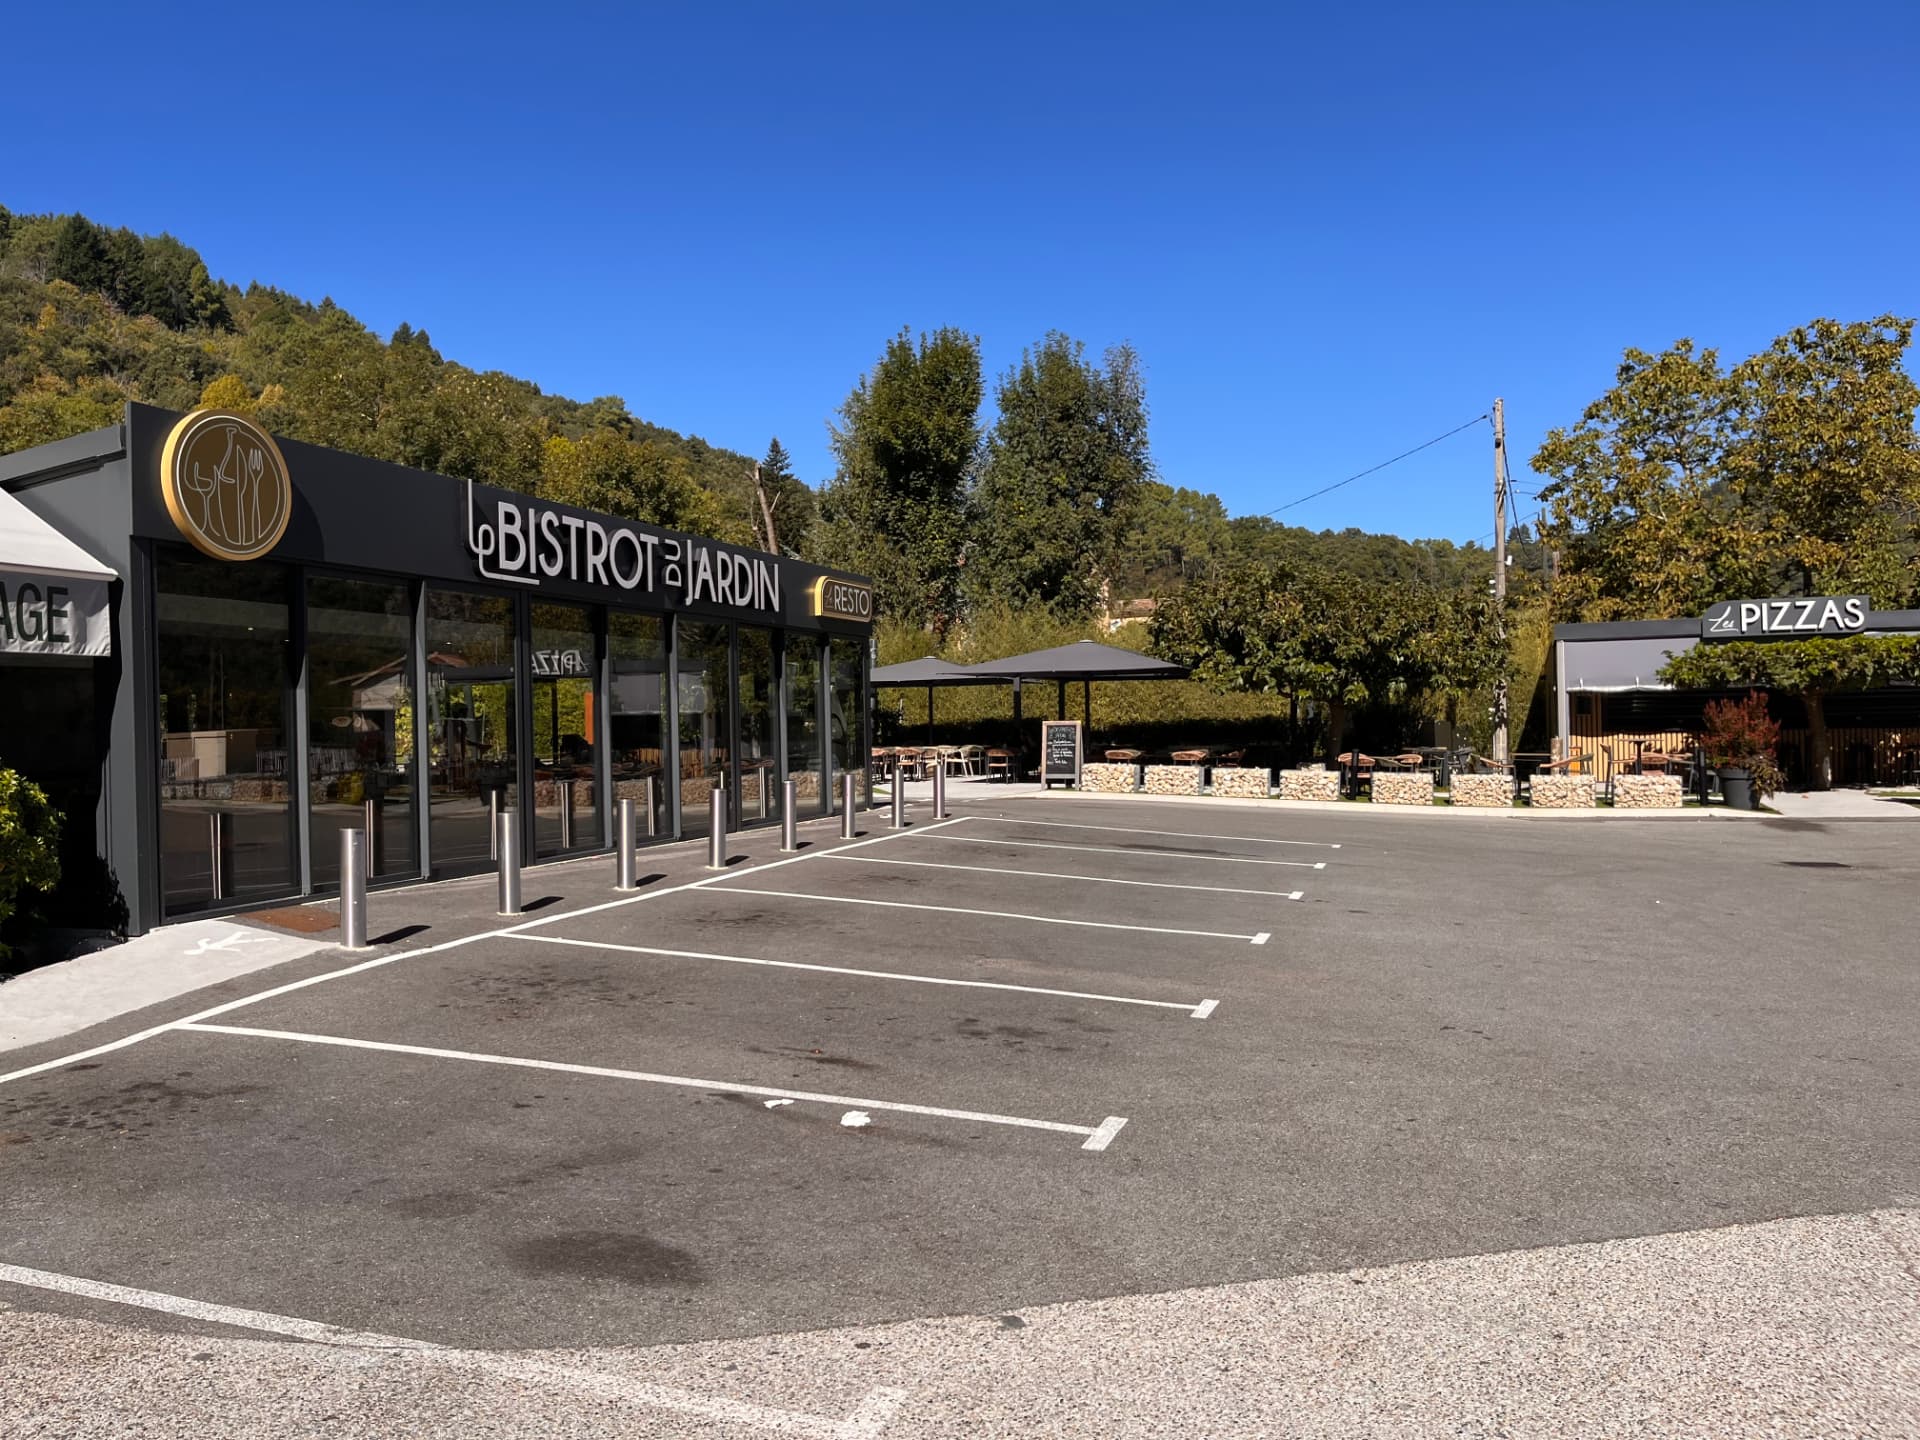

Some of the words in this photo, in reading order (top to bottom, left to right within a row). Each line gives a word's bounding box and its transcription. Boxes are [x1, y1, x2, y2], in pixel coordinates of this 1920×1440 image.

[498, 501, 659, 592] BISTROT
[664, 539, 682, 587] DU
[685, 539, 779, 612] JARDIN
[834, 585, 870, 615] RESTO
[1708, 605, 1738, 632] Les
[1740, 598, 1865, 633] PIZZAS
